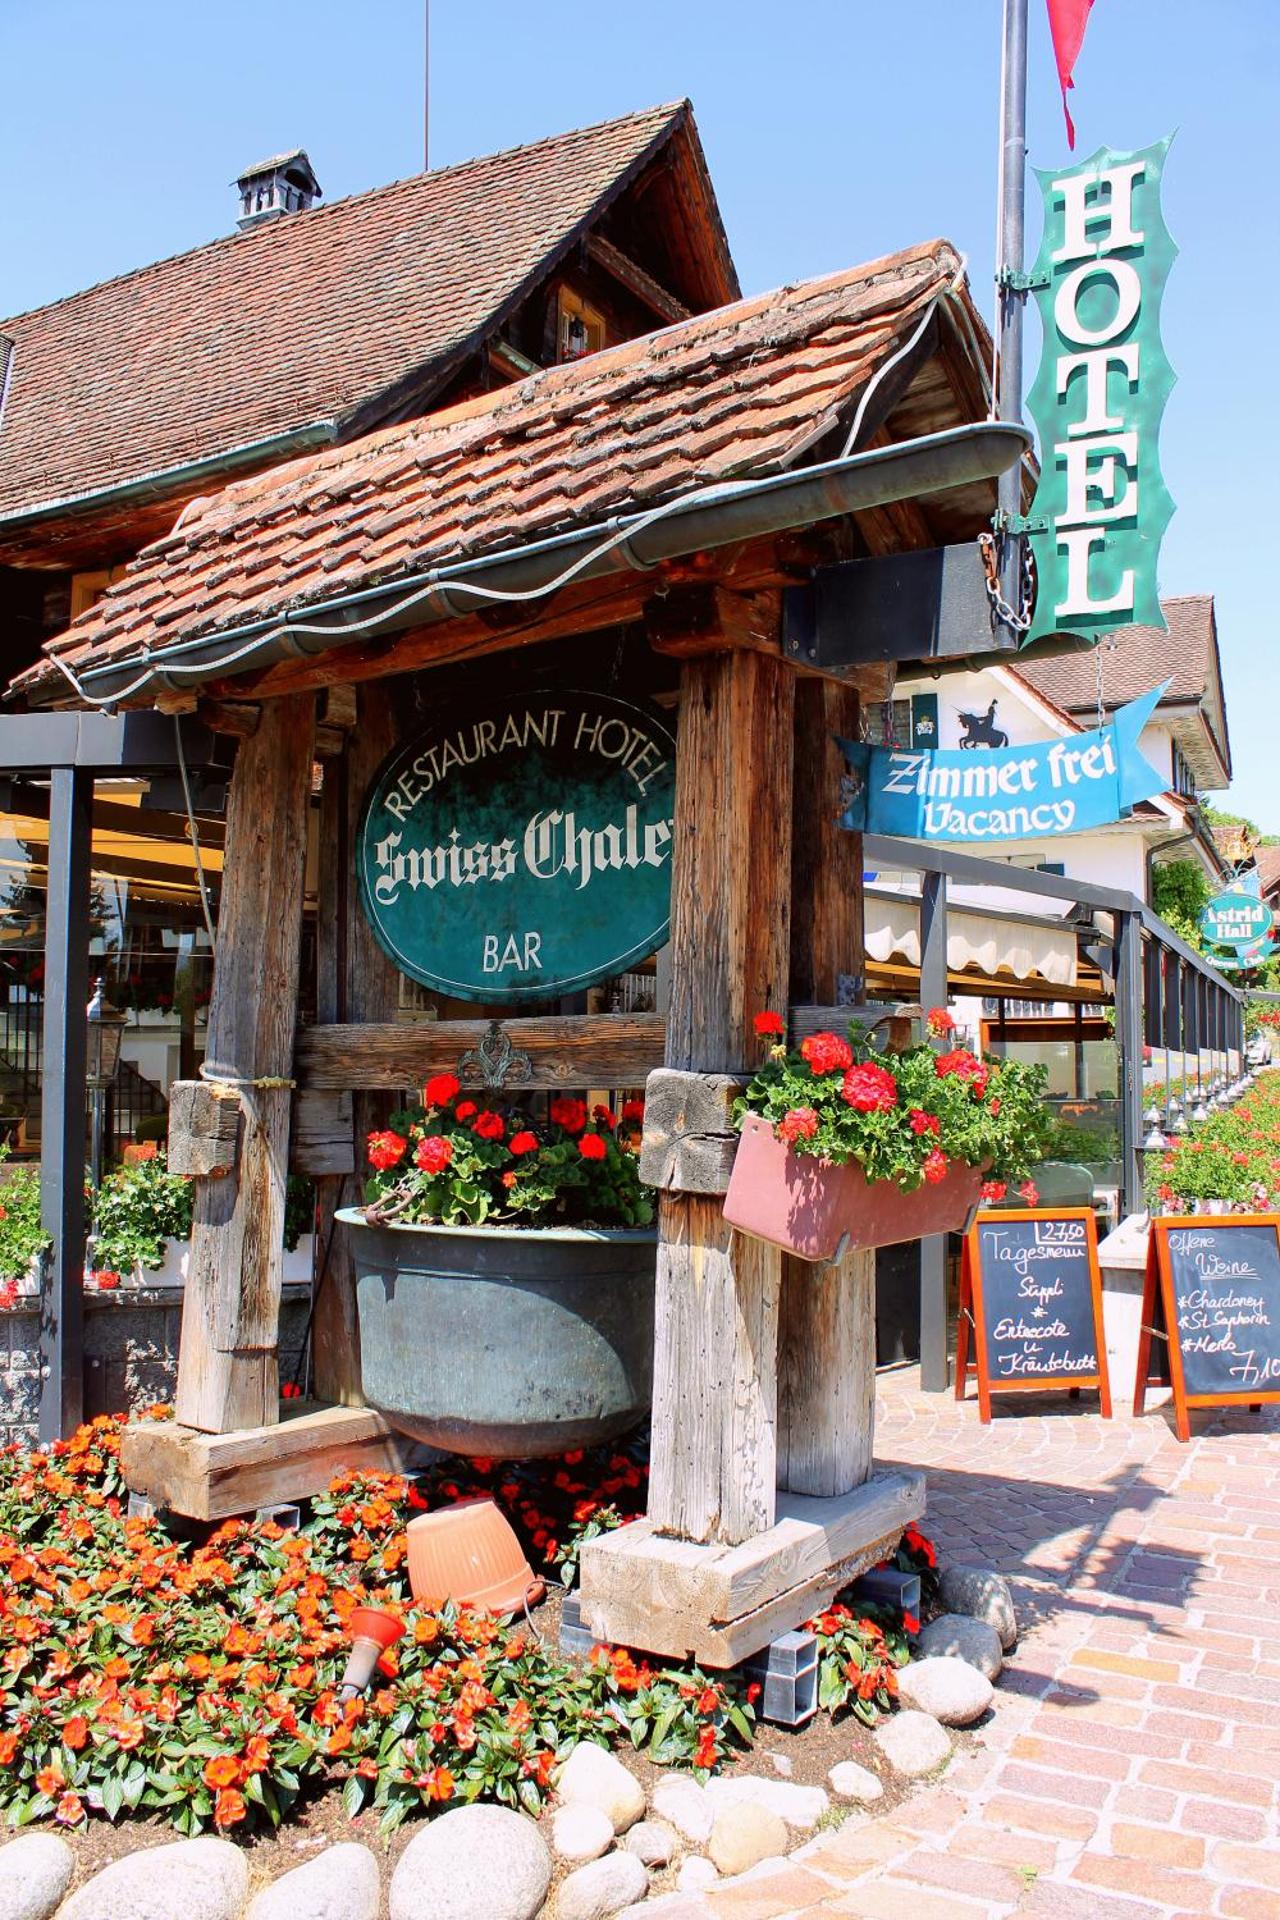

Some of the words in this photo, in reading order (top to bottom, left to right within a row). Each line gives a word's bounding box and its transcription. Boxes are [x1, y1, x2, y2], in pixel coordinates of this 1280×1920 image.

[1051, 160, 1145, 616] HOTEL
[383, 709, 566, 822] RESTAURANT
[573, 712, 667, 797] HOTEL
[881, 752, 1038, 798] Zimmer
[1047, 734, 1117, 788] frei
[924, 799, 1077, 836] Vacancy
[373, 827, 519, 906] Swiss
[524, 803, 674, 891] Chale
[1205, 905, 1265, 923] Astrid
[1217, 923, 1252, 938] Hall
[482, 931, 543, 973] BAR
[1195, 1252, 1256, 1276] Weine
